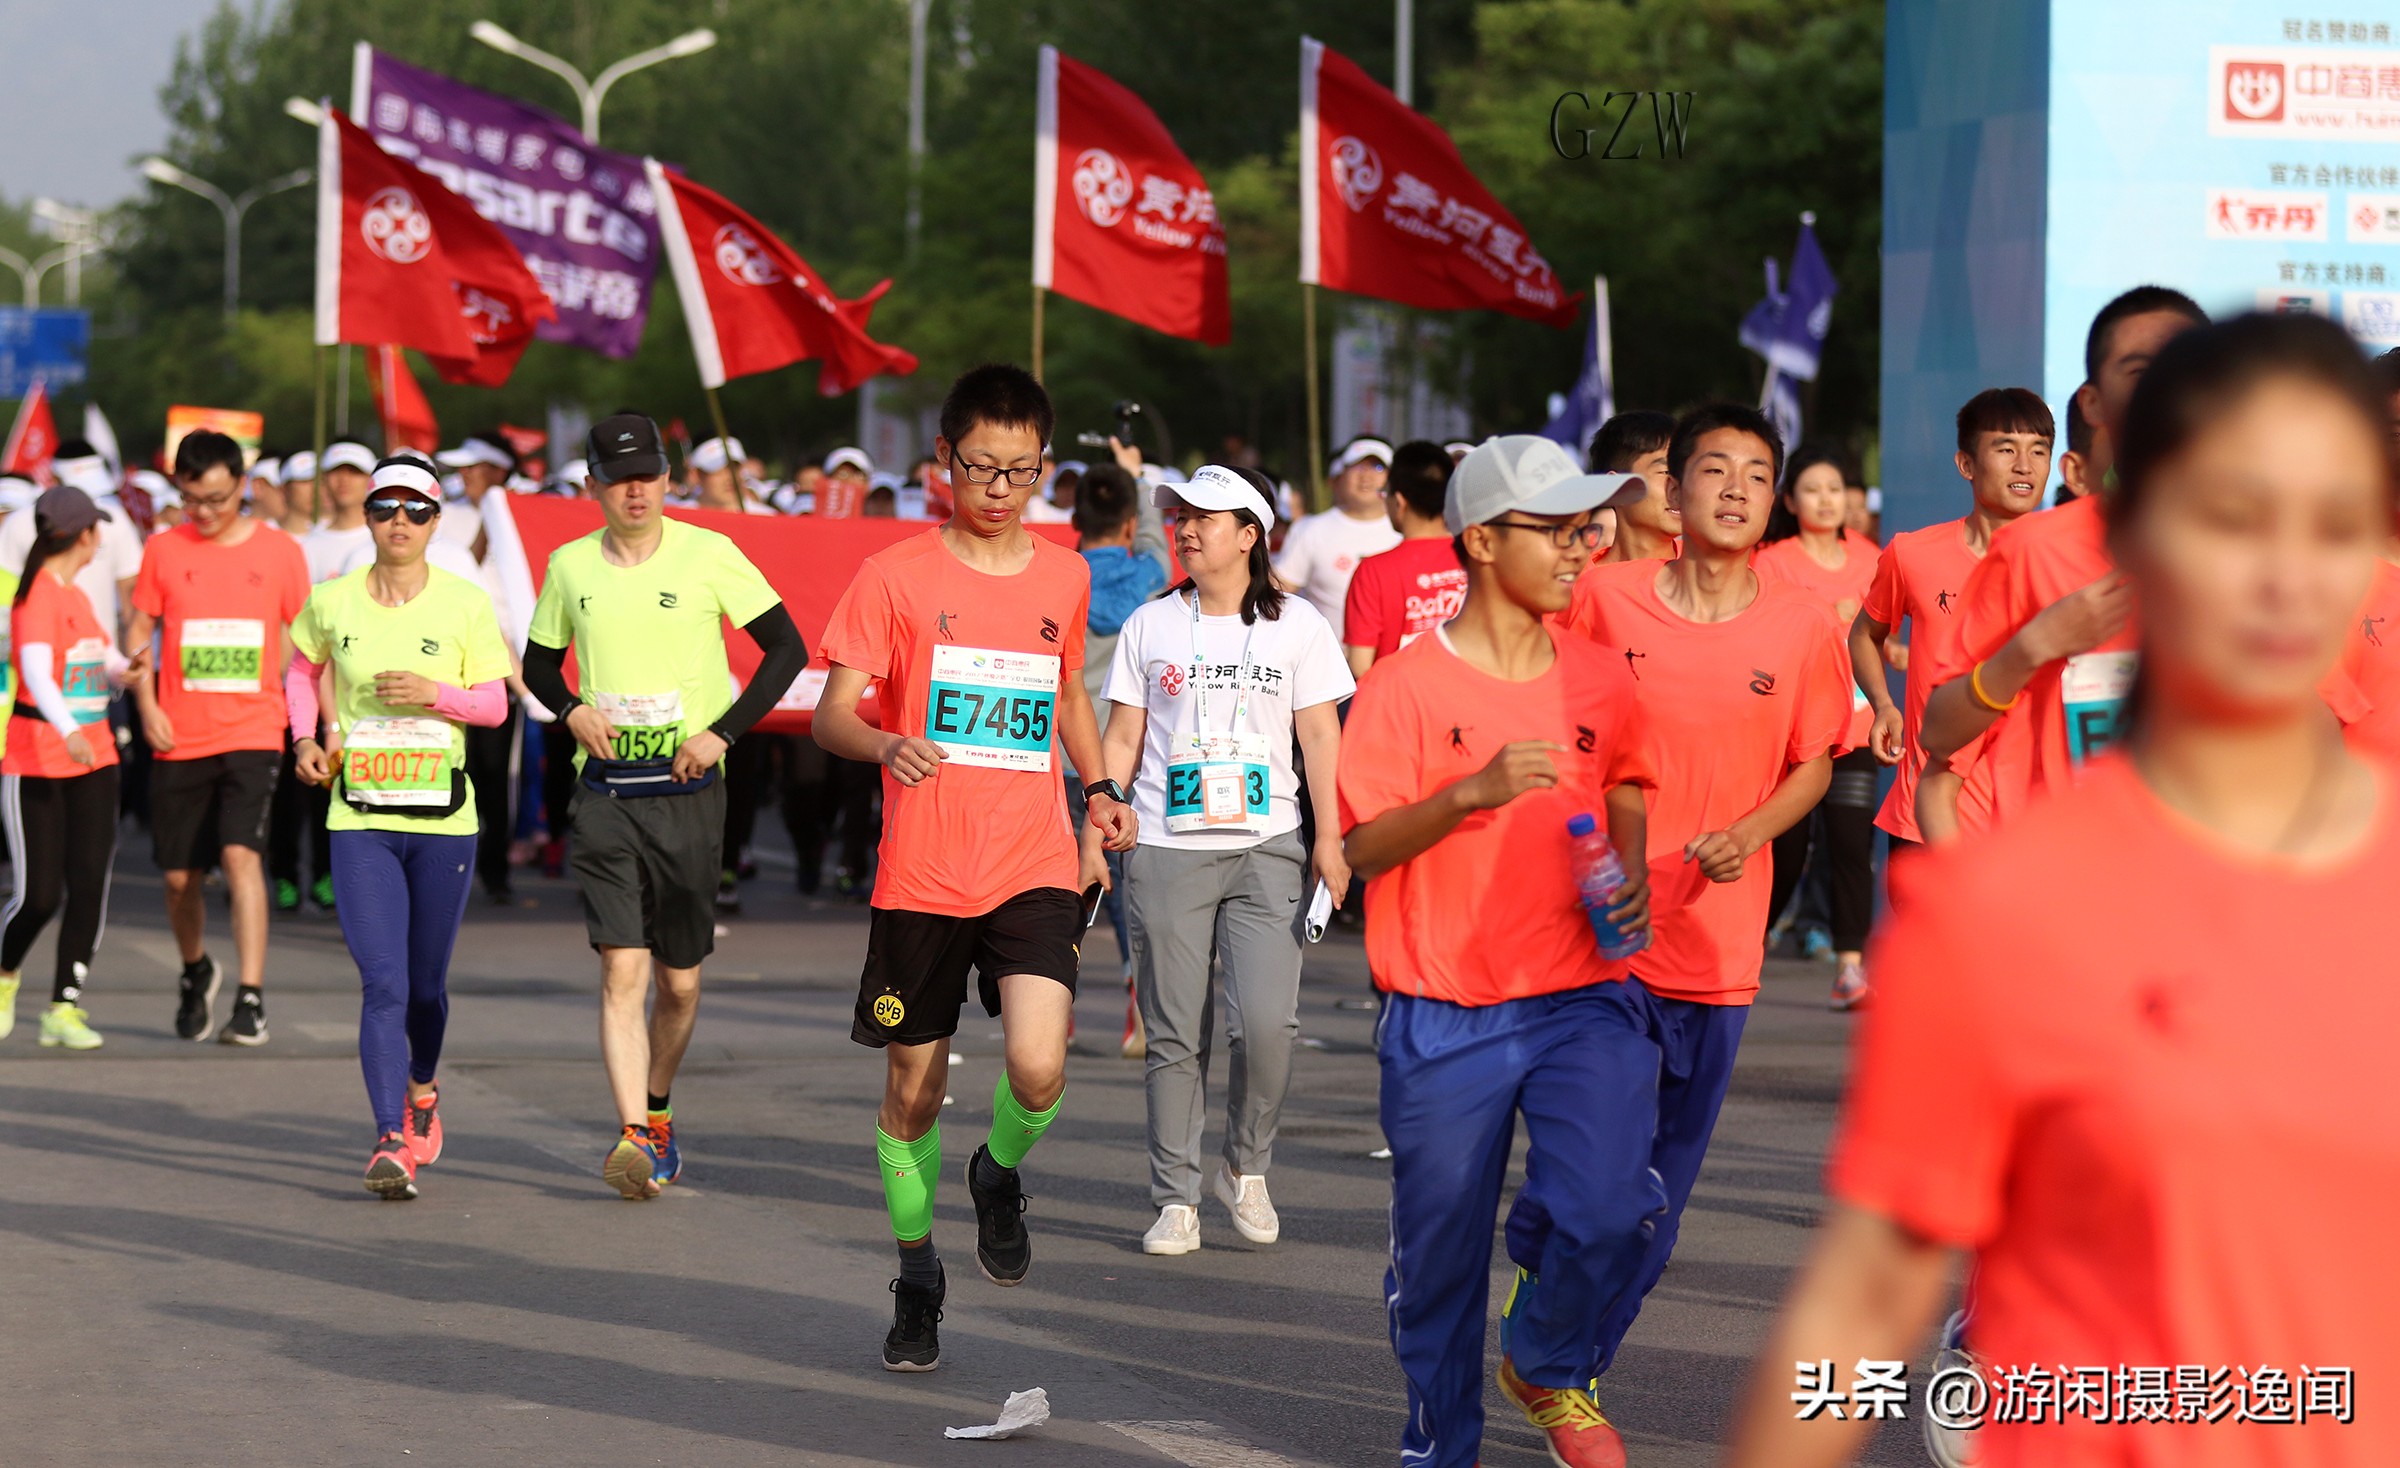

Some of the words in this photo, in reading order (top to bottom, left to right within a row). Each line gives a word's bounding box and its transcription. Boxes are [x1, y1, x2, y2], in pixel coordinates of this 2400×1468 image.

[187, 649, 257, 675] A2355
[1188, 681, 1224, 690] Yow
[1230, 682, 1256, 692] Rir
[1261, 685, 1279, 697] Bank
[934, 688, 1050, 742] E7455
[610, 726, 678, 760] 0527
[350, 751, 443, 783] B0077
[1170, 769, 1264, 808] E23
[877, 999, 901, 1020] BVB
[882, 1017, 891, 1025] 09
